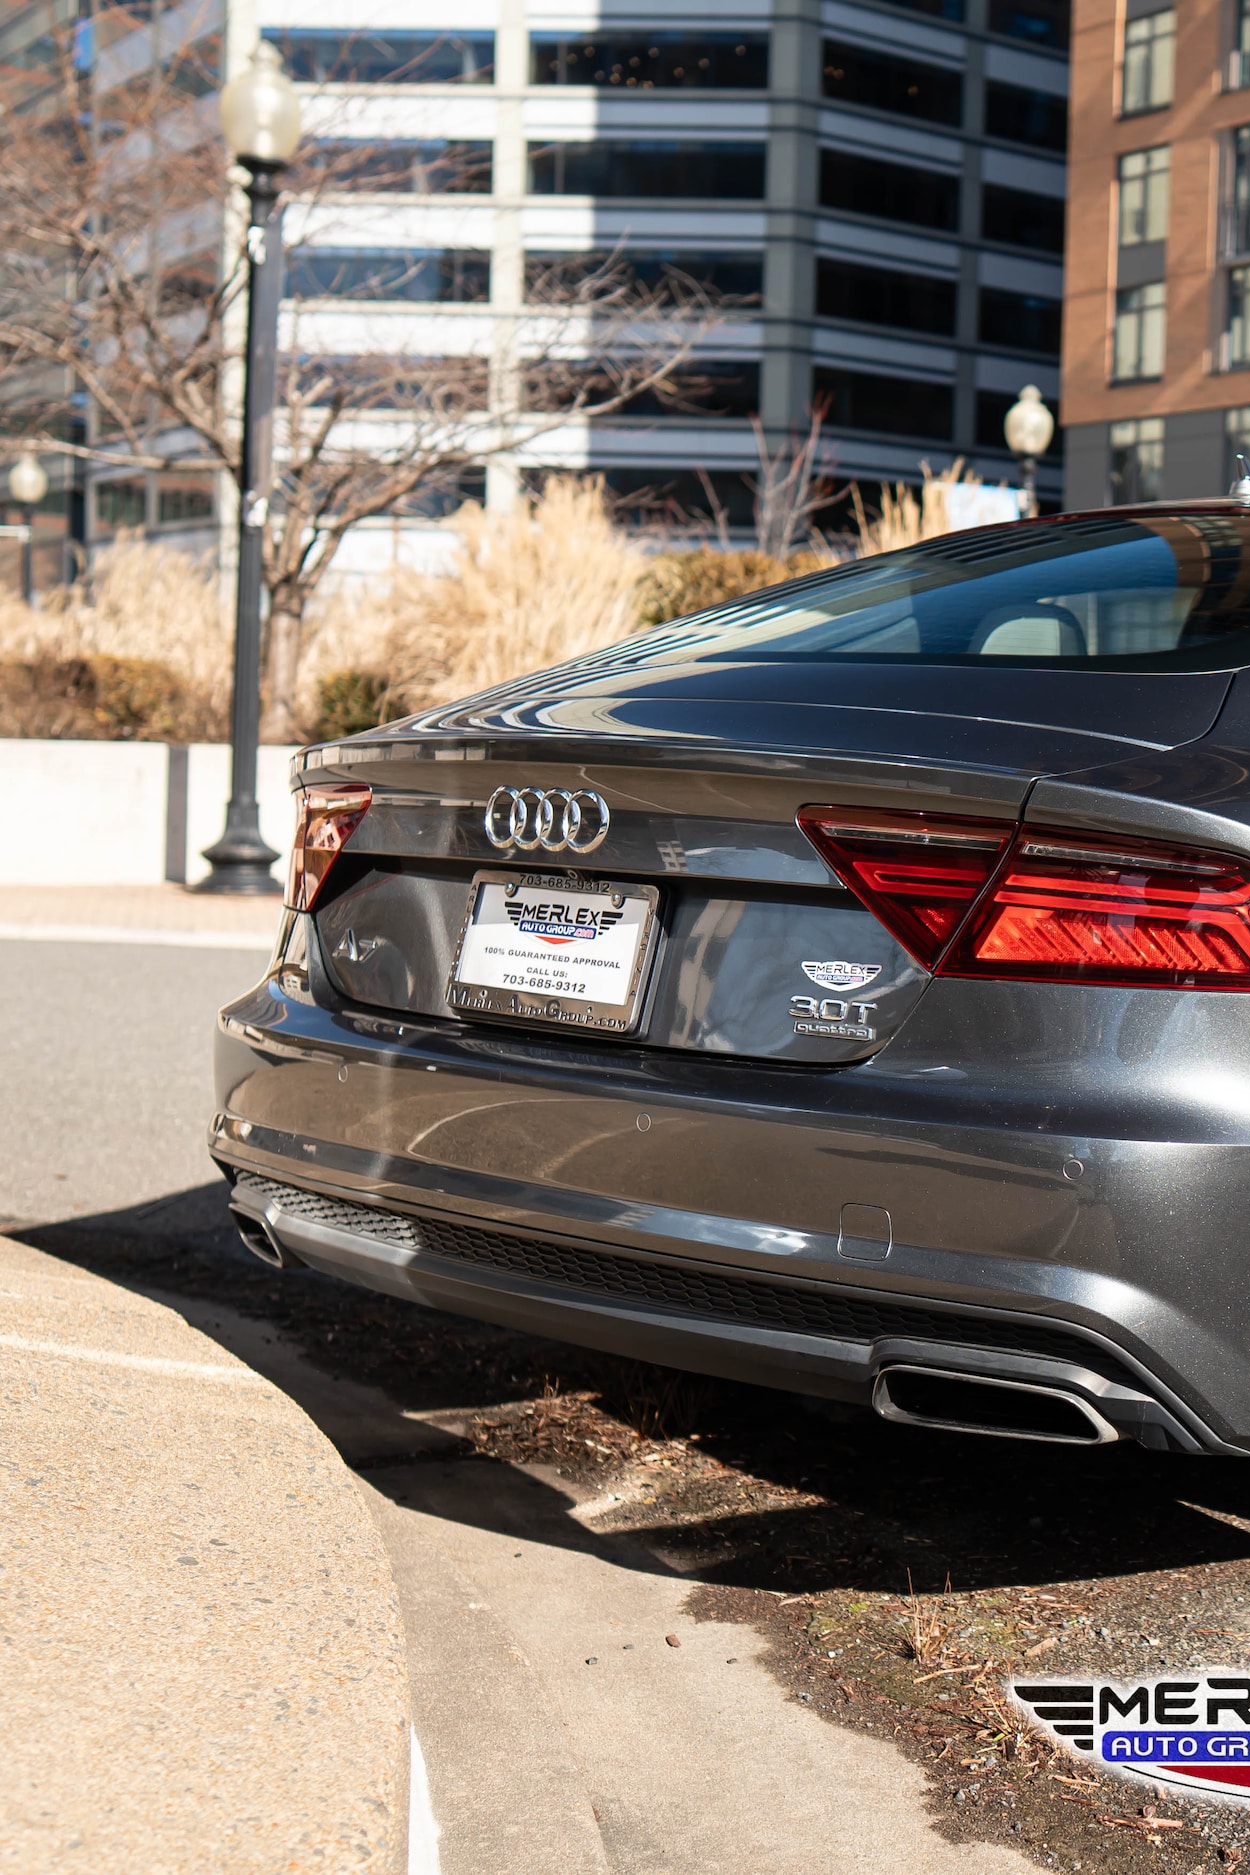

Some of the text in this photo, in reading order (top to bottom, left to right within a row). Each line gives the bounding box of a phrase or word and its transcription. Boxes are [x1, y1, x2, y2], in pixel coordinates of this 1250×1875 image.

[520, 873, 610, 893] 703-685-9312
[522, 904, 600, 926] MERLEX
[521, 922, 545, 932] AUTO
[332, 928, 377, 962] A7
[484, 946, 621, 969] 100% GUARANTEED APPROVAL
[526, 967, 568, 978] CALL US:
[816, 964, 865, 975] MERLEX
[503, 974, 586, 993] 703-685-9312
[797, 1023, 868, 1037] quattro
